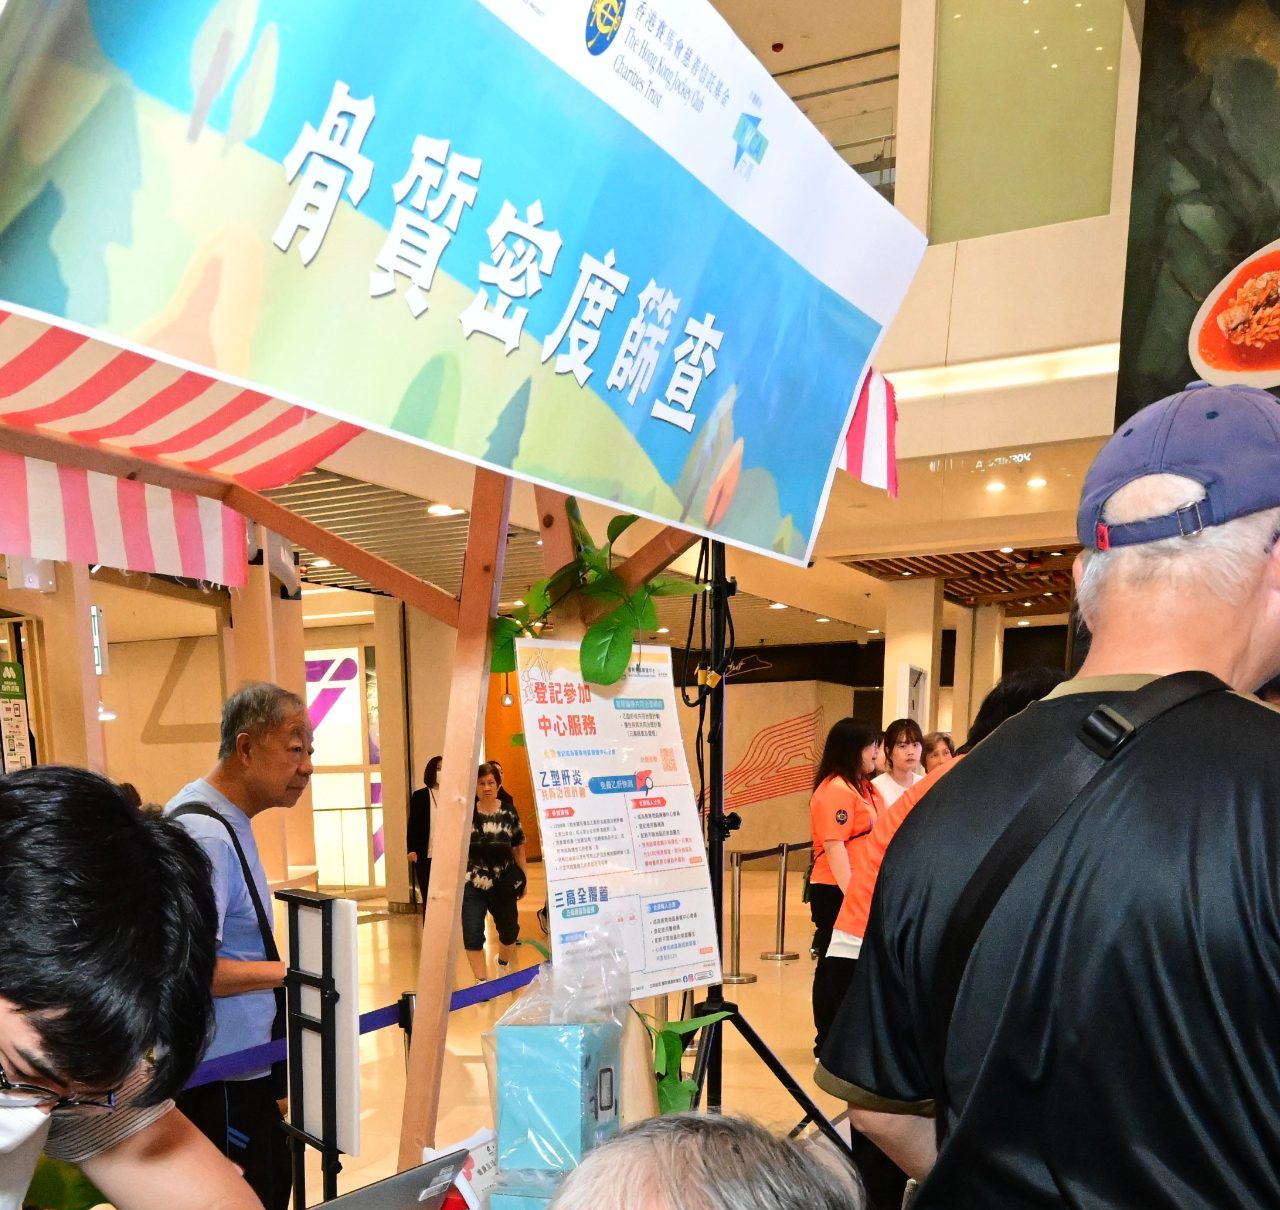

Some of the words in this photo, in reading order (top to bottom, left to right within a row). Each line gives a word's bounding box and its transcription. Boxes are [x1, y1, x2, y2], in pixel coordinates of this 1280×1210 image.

[624, 26, 640, 52] The
[638, 40, 658, 73] Hong
[656, 56, 675, 90] Kong
[670, 71, 693, 106] Jockey
[691, 90, 705, 113] Club
[613, 54, 644, 93] Charities
[643, 78, 663, 109] Trust
[273, 80, 724, 434] 骨質密度篩查
[534, 682, 592, 705] 登記參加
[538, 714, 597, 737] 中心服務
[539, 770, 583, 788] 乙型肝炎
[554, 886, 609, 908] 三高全覆蓋
